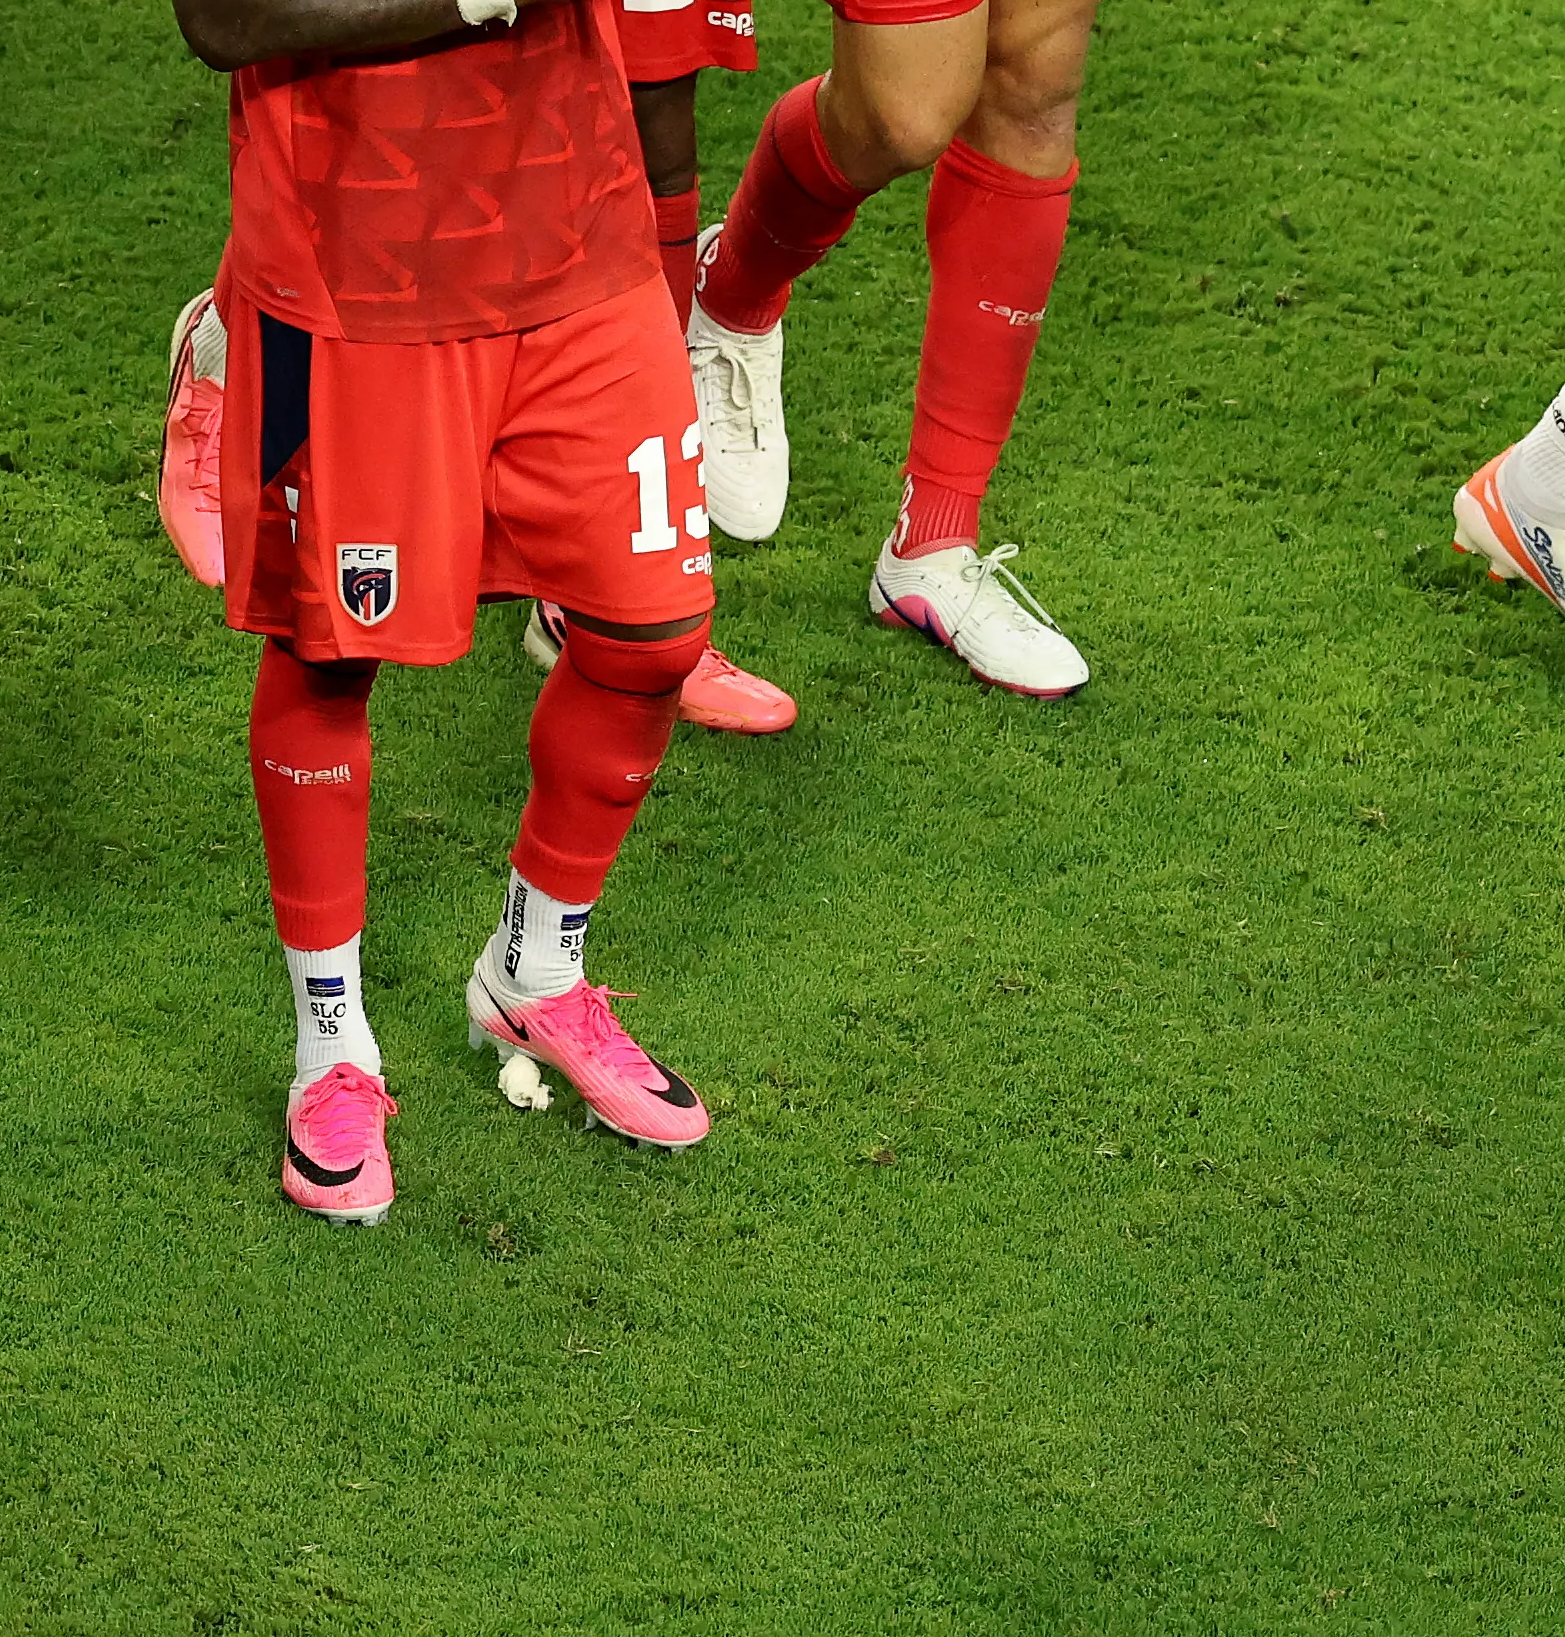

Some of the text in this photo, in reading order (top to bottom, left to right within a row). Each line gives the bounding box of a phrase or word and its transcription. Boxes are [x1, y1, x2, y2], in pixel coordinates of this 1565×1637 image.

[342, 549, 392, 561] FCF
[264, 759, 352, 785] capelli
[570, 949, 580, 962] 5
[310, 1002, 347, 1019] SLC
[318, 1019, 339, 1035] 55
